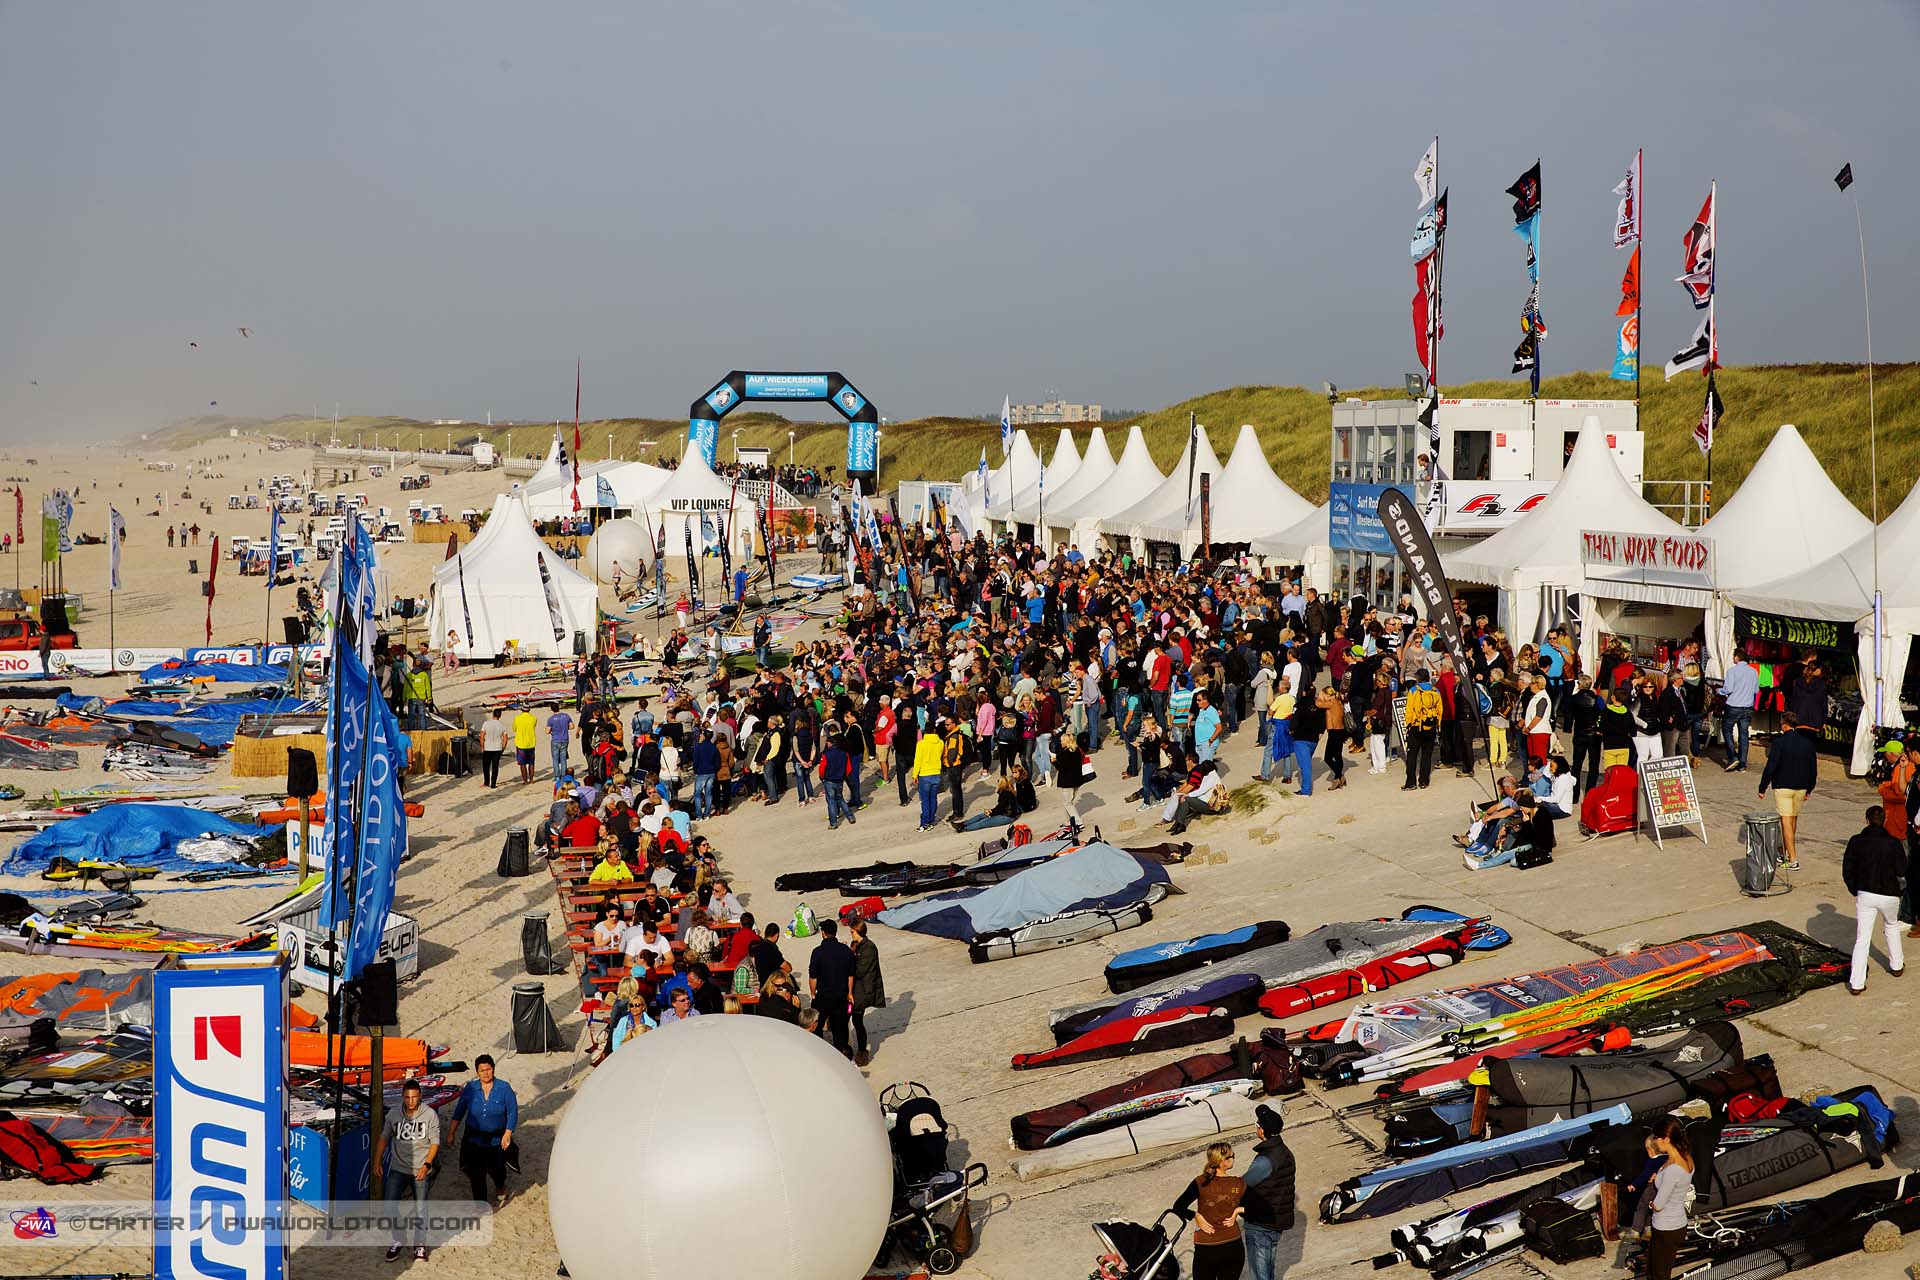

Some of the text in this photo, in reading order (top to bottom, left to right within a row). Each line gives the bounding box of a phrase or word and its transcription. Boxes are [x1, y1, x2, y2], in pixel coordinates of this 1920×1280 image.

[766, 376, 824, 384] WIEDERSEHEN
[671, 499, 730, 510] VIP LOUNGE
[1583, 532, 1709, 570] THAI WOK FOOD
[1750, 615, 1838, 648] SYLT BRANDS
